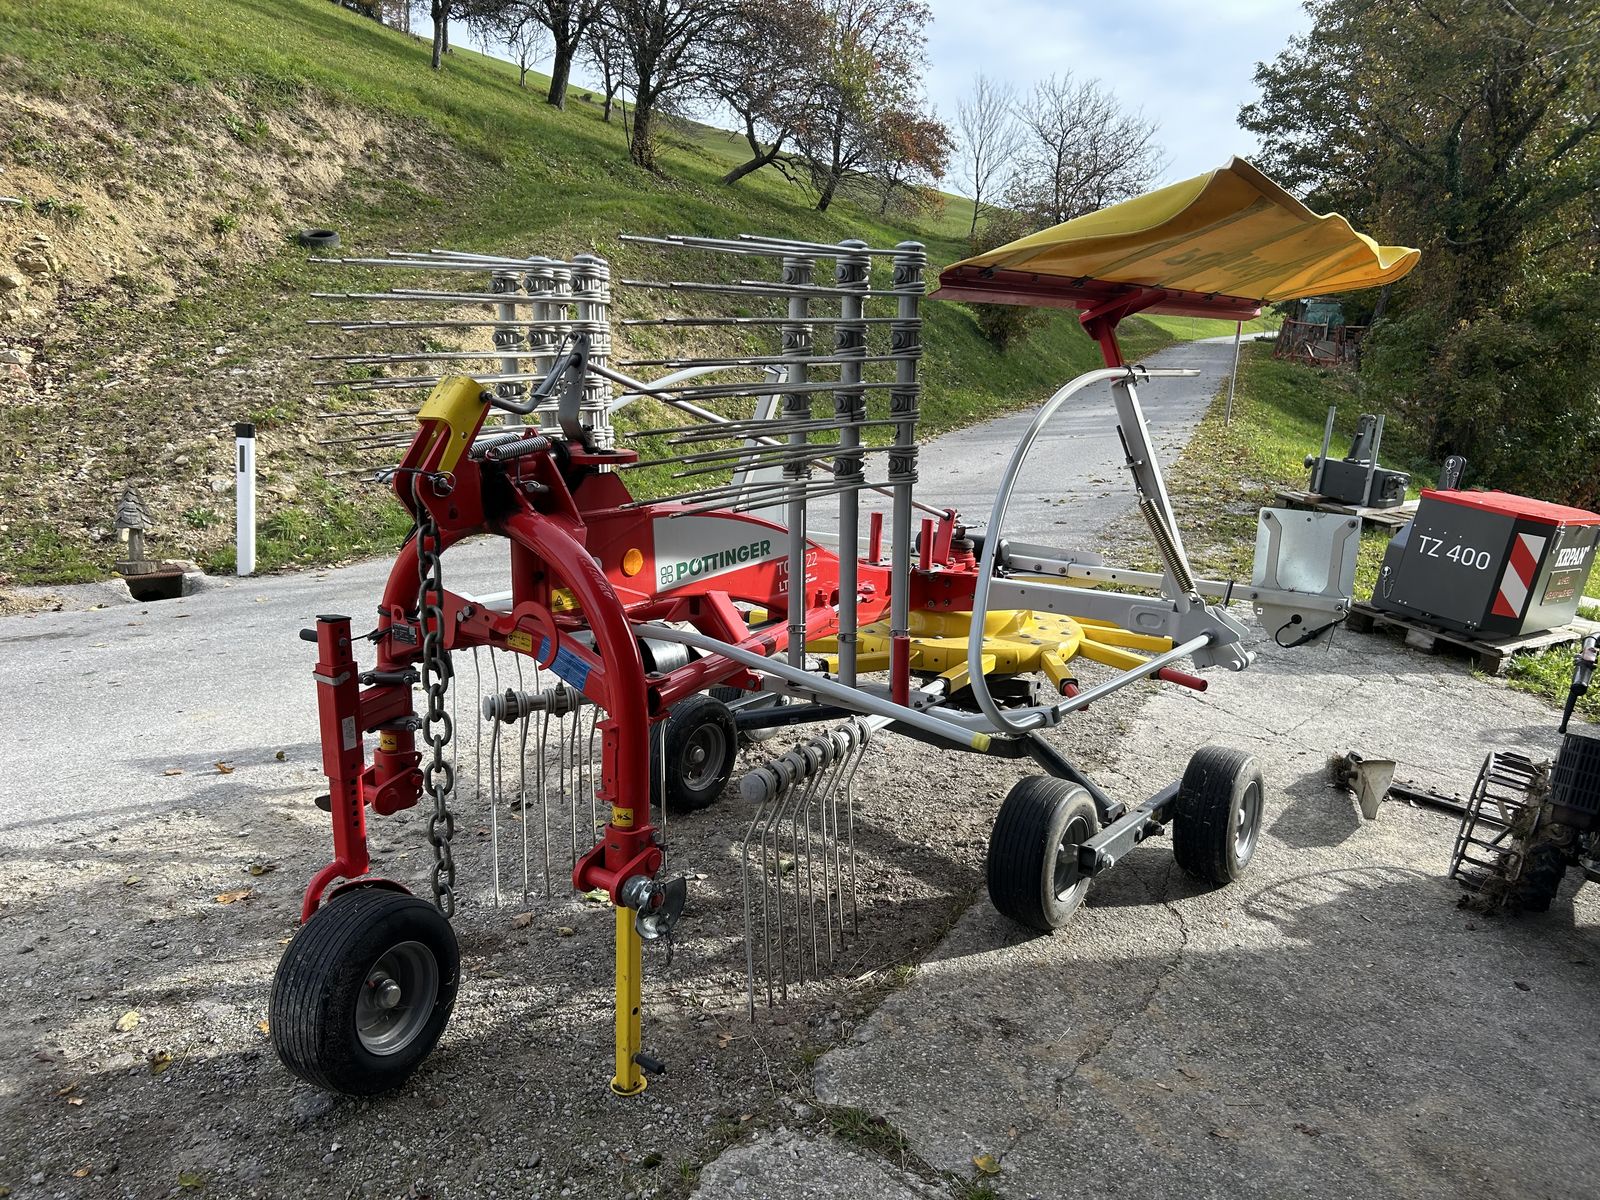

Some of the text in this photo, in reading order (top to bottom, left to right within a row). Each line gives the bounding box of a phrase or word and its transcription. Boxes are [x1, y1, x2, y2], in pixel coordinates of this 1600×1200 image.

[676, 540, 770, 580] PÖTTINGER
[1419, 535, 1491, 571] TZ 400
[1555, 545, 1588, 567] KRPAN
